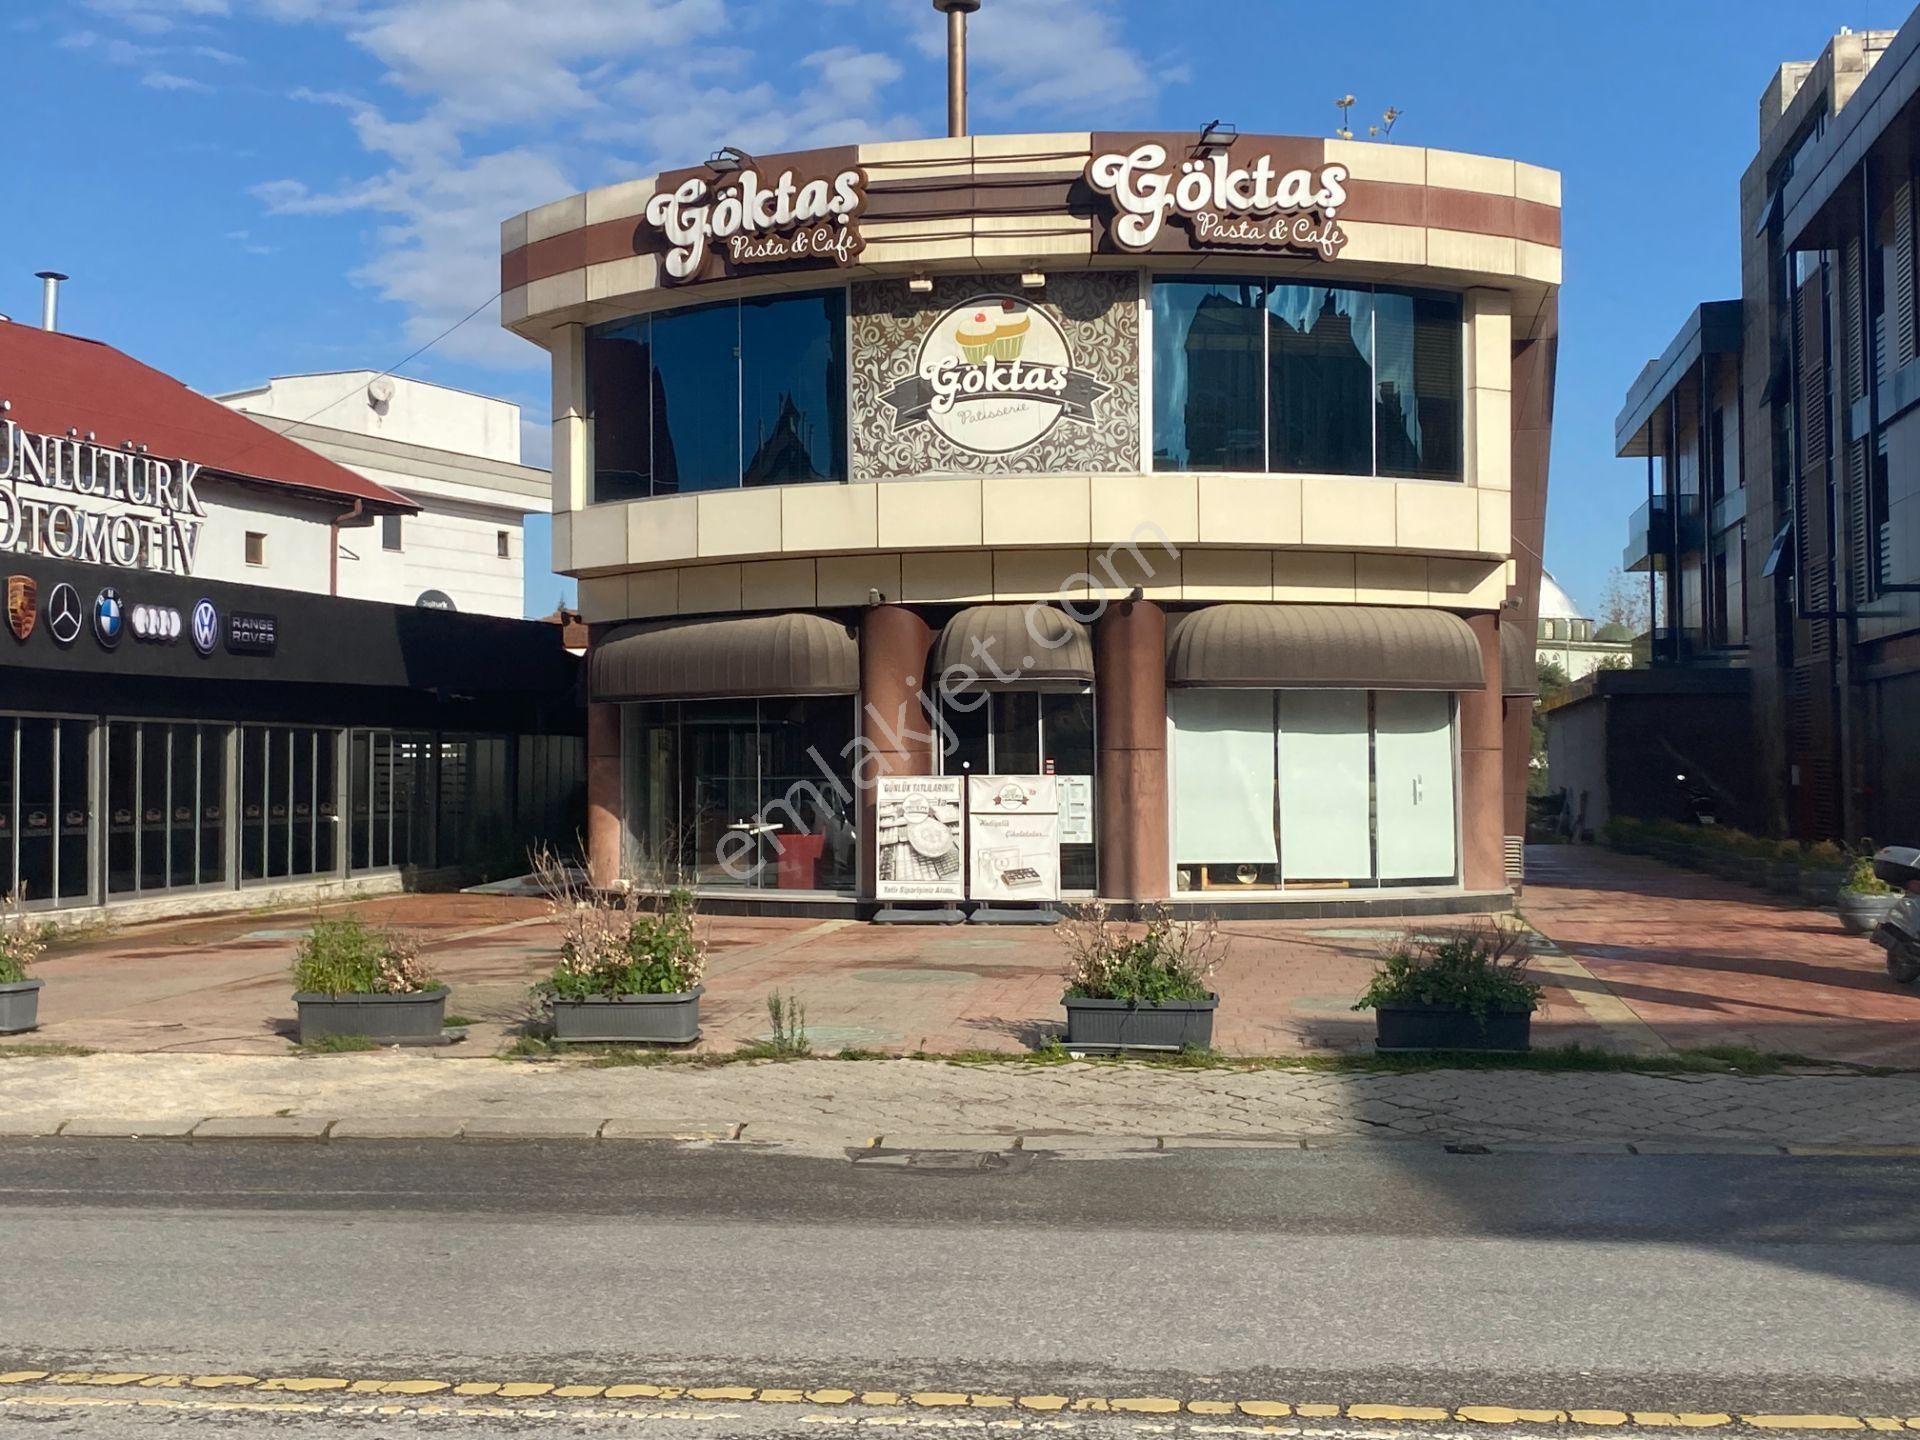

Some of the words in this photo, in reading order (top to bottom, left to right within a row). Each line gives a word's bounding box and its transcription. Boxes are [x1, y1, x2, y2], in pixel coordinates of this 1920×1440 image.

[1091, 144, 1347, 247] Göktaş
[646, 170, 860, 278] Göktaş
[1197, 212, 1265, 239] Pasta
[1269, 218, 1288, 240] &
[731, 235, 788, 259] Pasta
[792, 231, 809, 254] &
[919, 354, 1069, 414] Göktaş
[956, 401, 1031, 425] Patisserie
[232, 616, 274, 631] RANGE
[232, 630, 275, 644] ROVER
